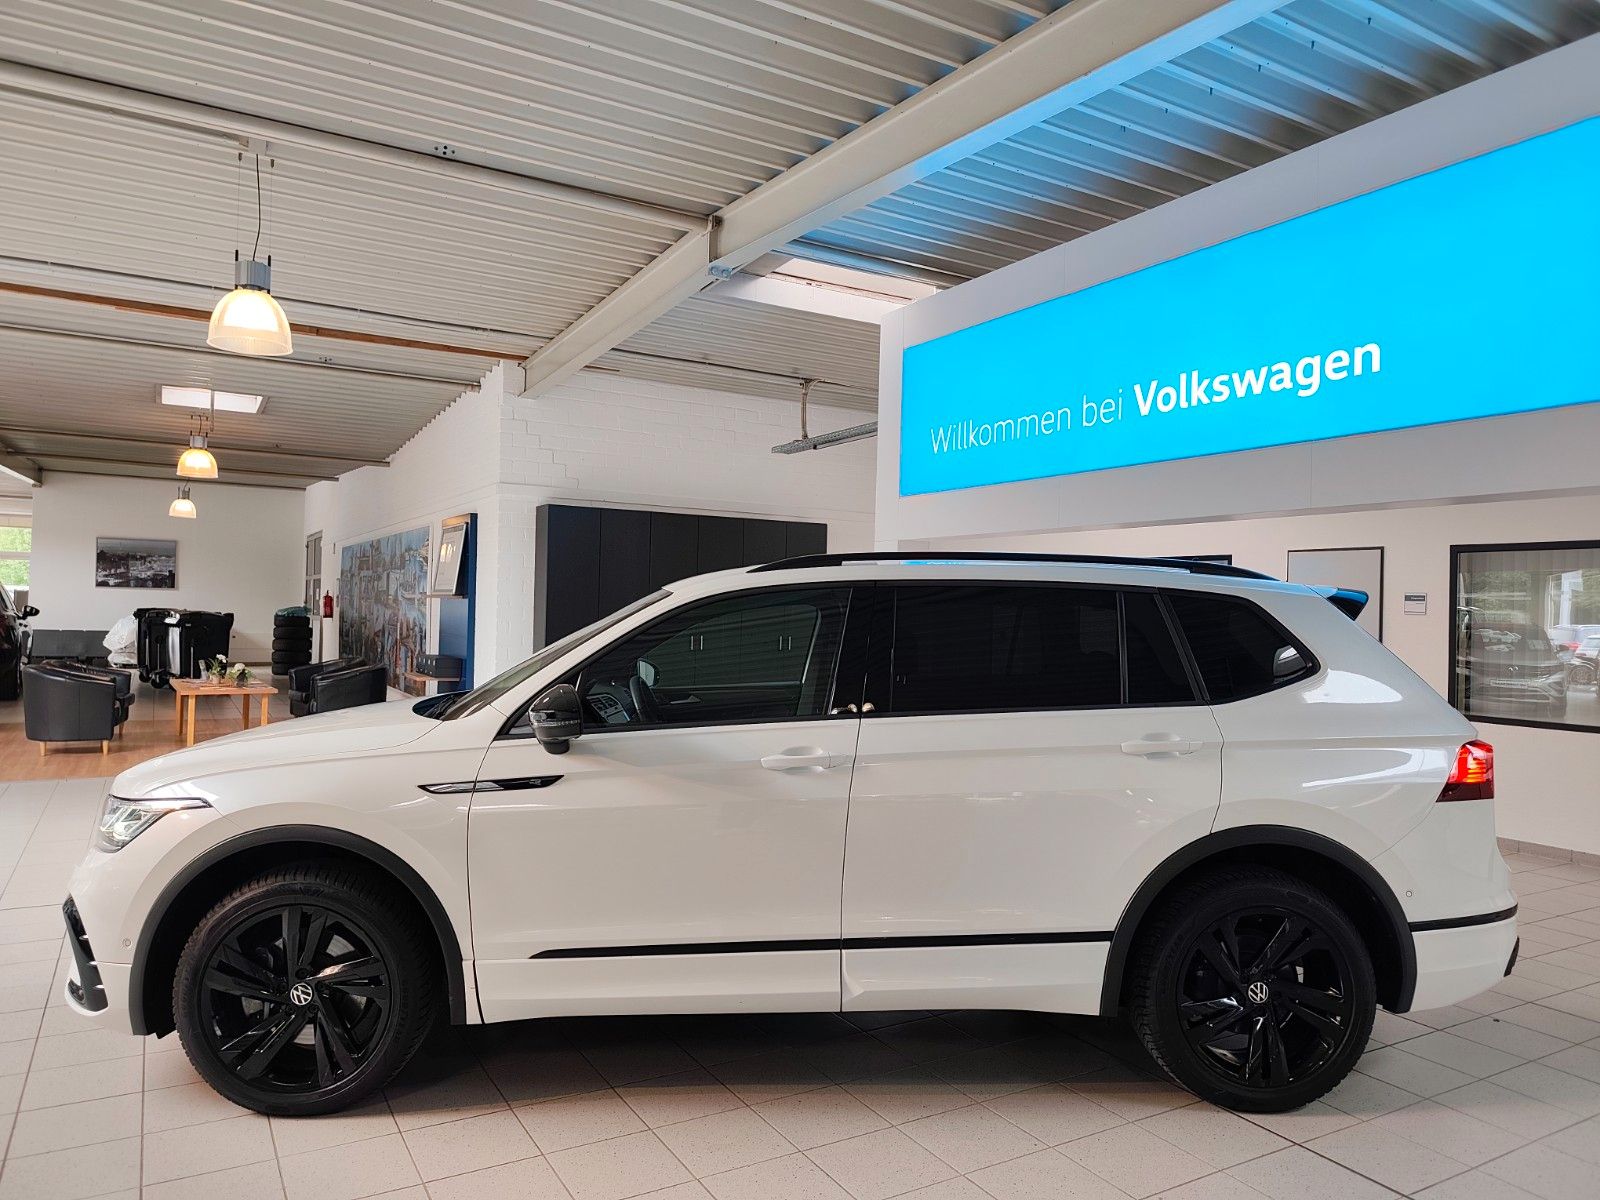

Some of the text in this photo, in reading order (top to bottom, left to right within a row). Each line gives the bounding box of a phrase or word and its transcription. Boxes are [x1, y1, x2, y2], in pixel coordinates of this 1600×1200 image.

[930, 342, 1381, 454] Willkommen bei Volkswagen
